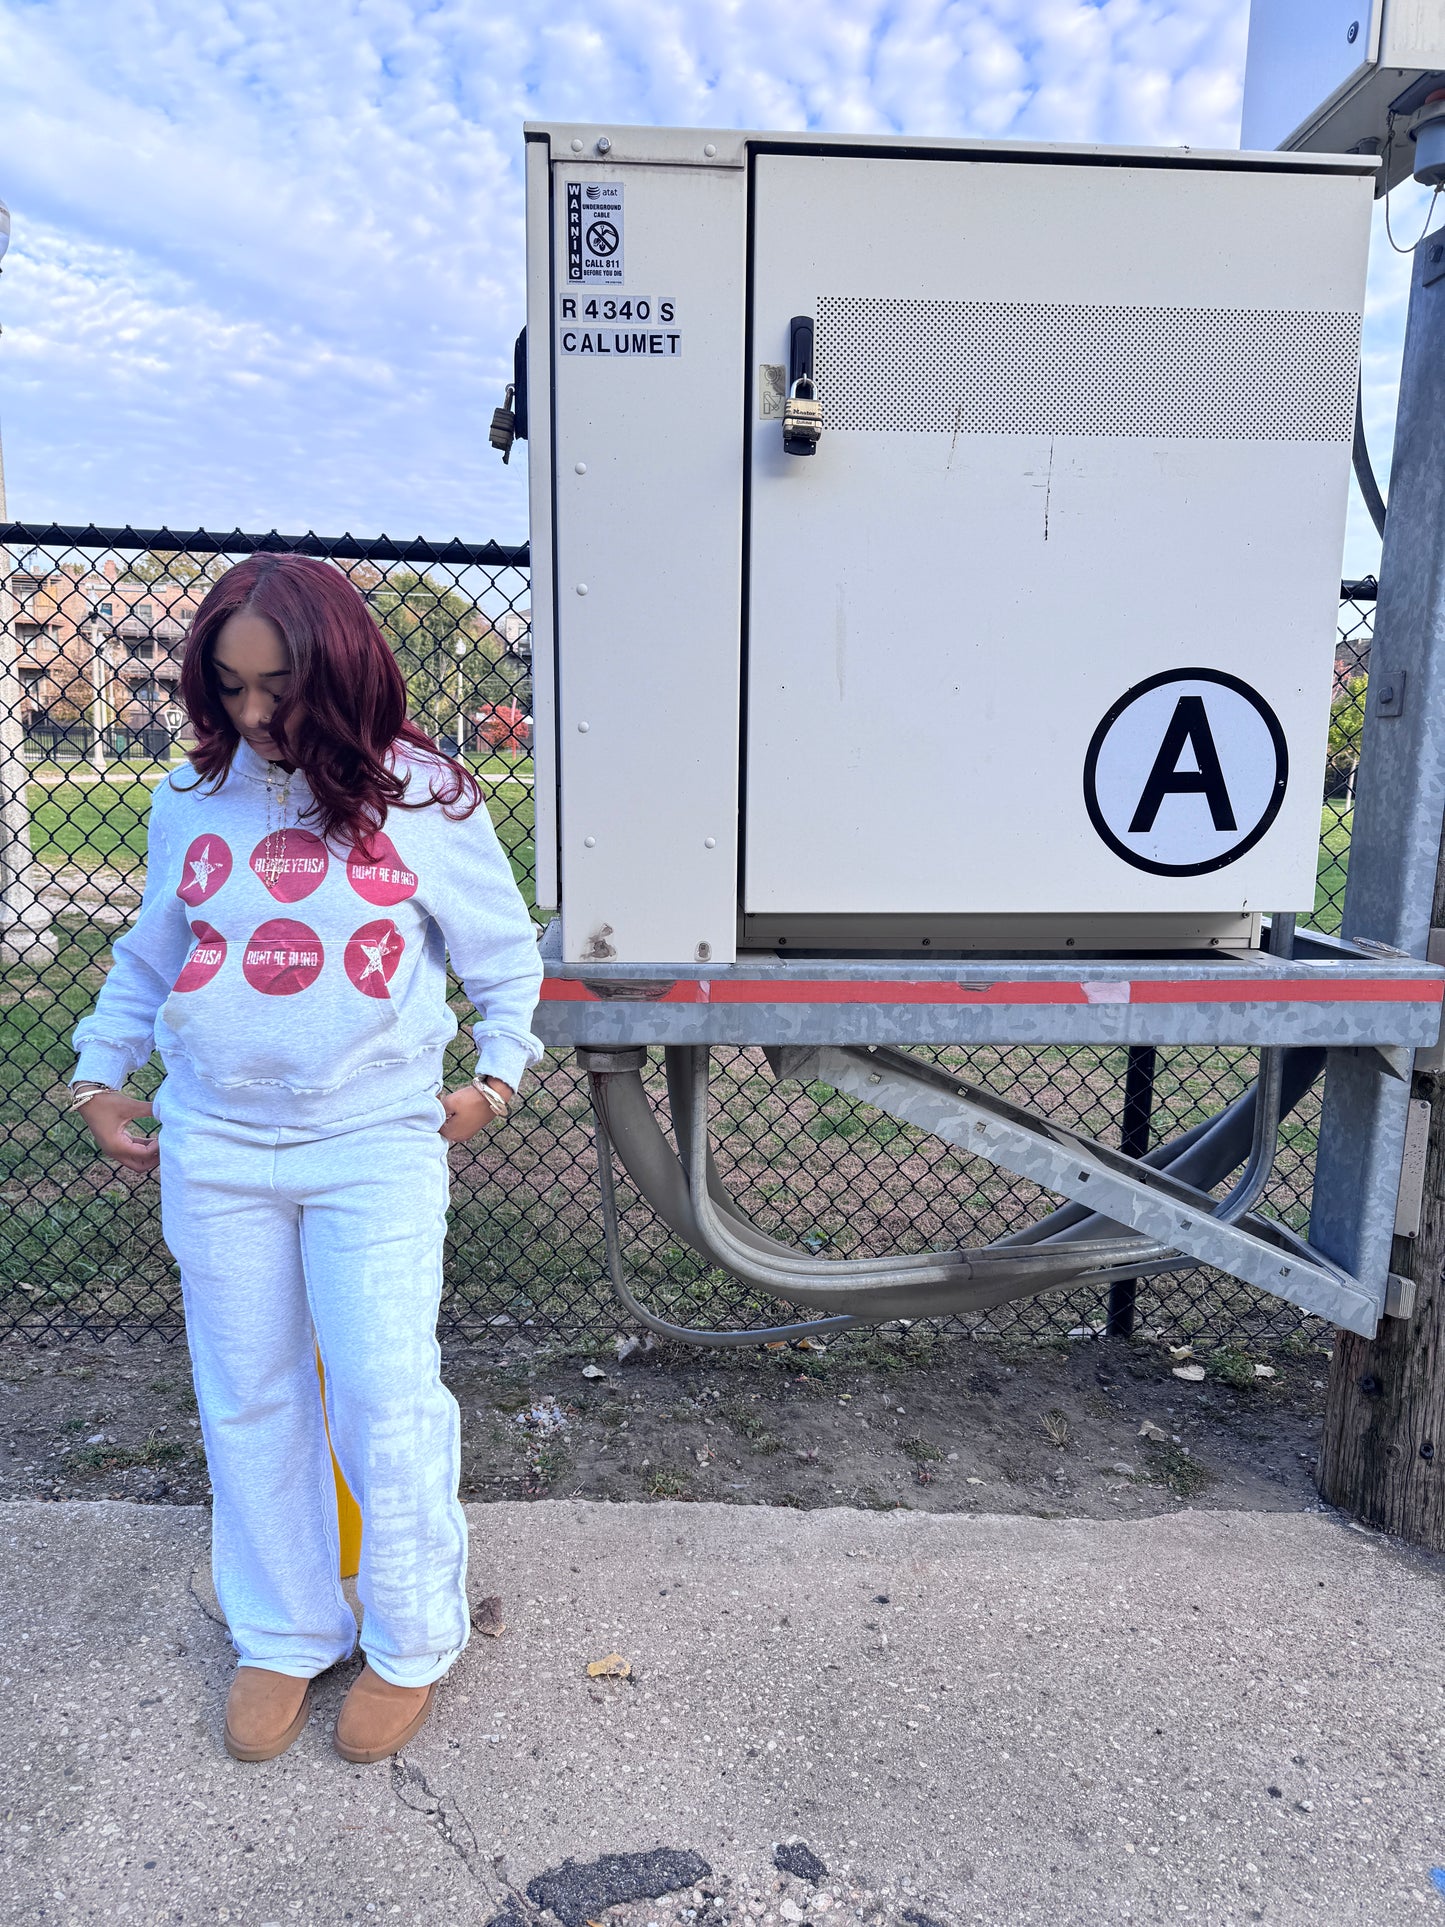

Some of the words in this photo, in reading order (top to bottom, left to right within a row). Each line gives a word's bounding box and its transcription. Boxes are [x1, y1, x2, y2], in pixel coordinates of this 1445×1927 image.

[602, 188, 618, 197] at&t
[582, 203, 621, 211] UNDERGROUND
[593, 211, 611, 219] CABLE
[568, 185, 580, 278] WARNING
[585, 259, 604, 268] CALL
[606, 259, 620, 268] 811
[583, 269, 602, 277] BEFORE
[603, 269, 613, 277] YOU
[562, 298, 576, 318] R
[585, 299, 650, 320] 4340
[660, 302, 674, 322] S
[562, 332, 680, 354] CALUMET
[1128, 695, 1238, 833] A
